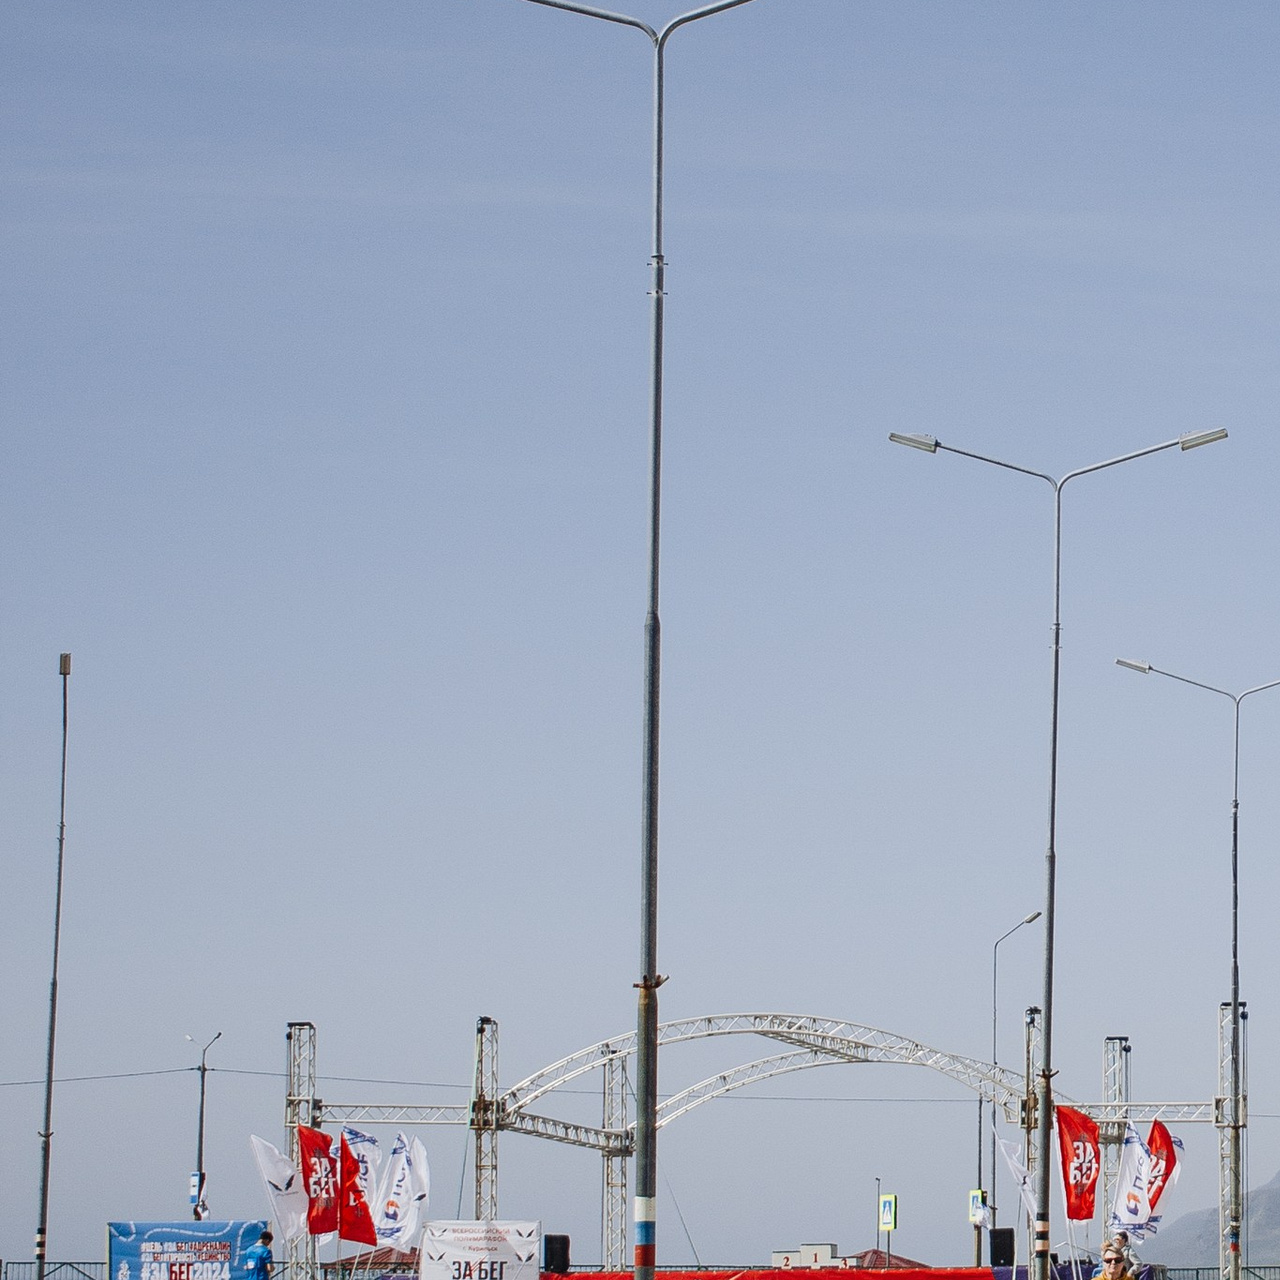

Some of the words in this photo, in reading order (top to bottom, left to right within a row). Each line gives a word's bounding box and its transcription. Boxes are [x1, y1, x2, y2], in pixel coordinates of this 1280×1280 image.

[1071, 1141, 1096, 1164] ЗА
[310, 1157, 333, 1178] ЗА
[309, 1177, 337, 1199] БЕГ
[452, 1261, 473, 1280] ЗА
[478, 1261, 508, 1280] БЕГ
[783, 1256, 790, 1267] 2
[813, 1252, 818, 1263] 1
[841, 1258, 848, 1269] 3
